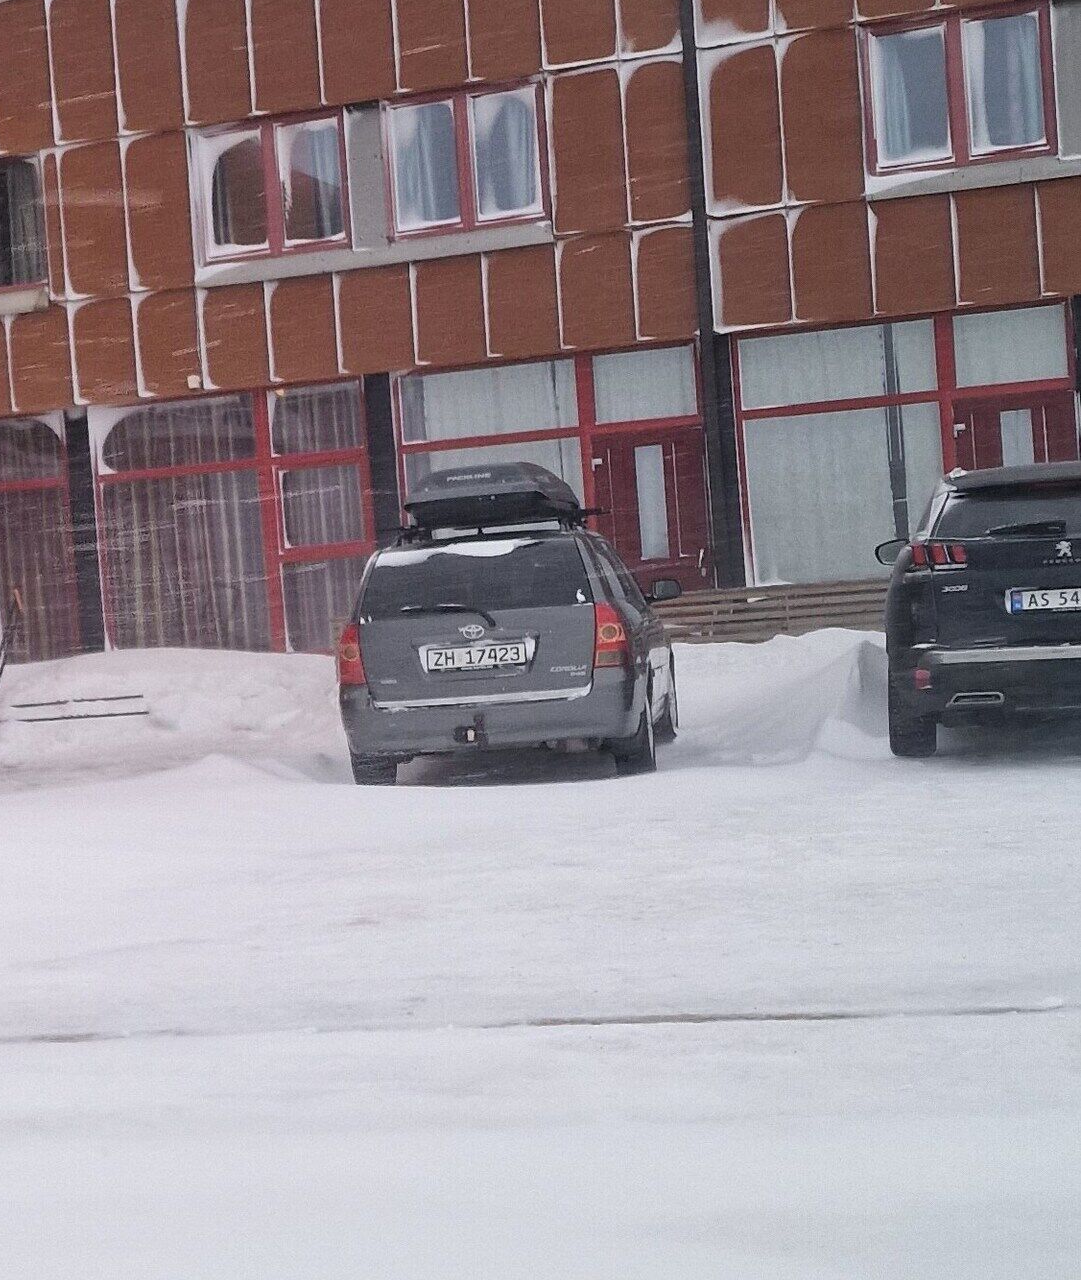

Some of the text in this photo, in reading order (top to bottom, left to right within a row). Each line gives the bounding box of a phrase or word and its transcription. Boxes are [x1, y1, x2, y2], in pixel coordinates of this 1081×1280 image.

[1028, 591, 1080, 608] AS 54
[433, 646, 521, 667] ZH 17423
